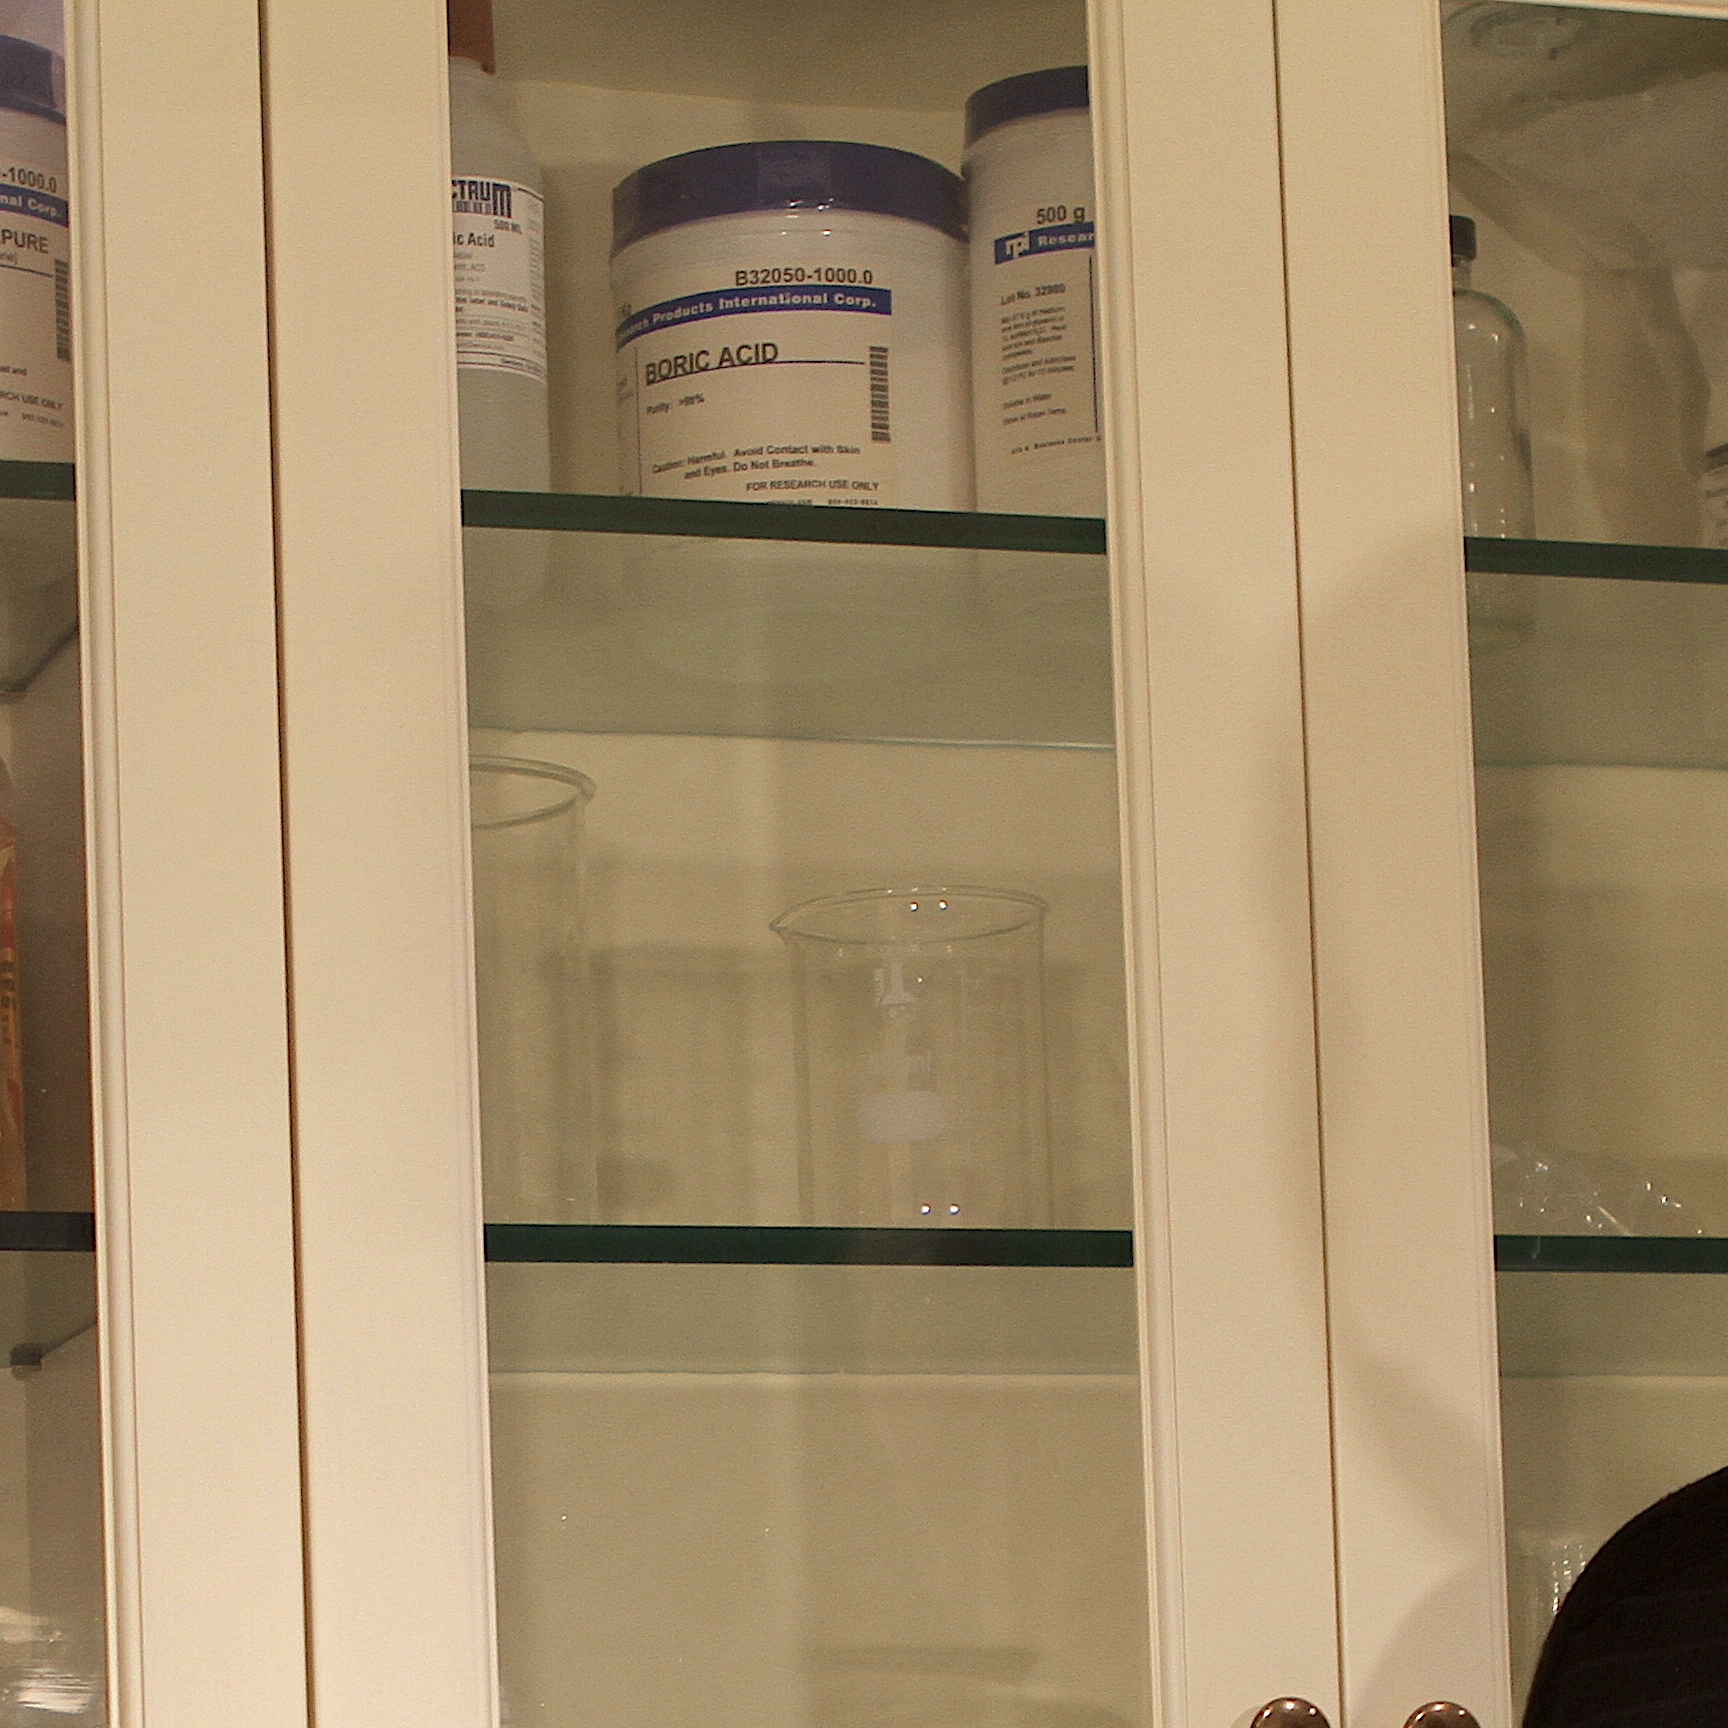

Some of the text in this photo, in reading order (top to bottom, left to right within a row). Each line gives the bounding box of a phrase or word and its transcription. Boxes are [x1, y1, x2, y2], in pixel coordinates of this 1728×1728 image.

[27, 199, 60, 217] Corp.
[1037, 205, 1086, 225] 500 g
[468, 232, 495, 248] Acid
[735, 267, 873, 287] B32050-1000.0
[652, 301, 714, 325] Products
[718, 291, 828, 311] International
[833, 293, 876, 309] Corp.
[645, 342, 779, 386] BORIC ACID
[733, 445, 764, 458] Avoid
[766, 444, 809, 456] Contact
[811, 443, 834, 454] with
[836, 445, 861, 455] Skin
[733, 461, 748, 472] Do
[750, 459, 770, 470] Not
[772, 457, 816, 469] Breathe.
[746, 479, 879, 492] FOR RESEARCH USE ONLY
